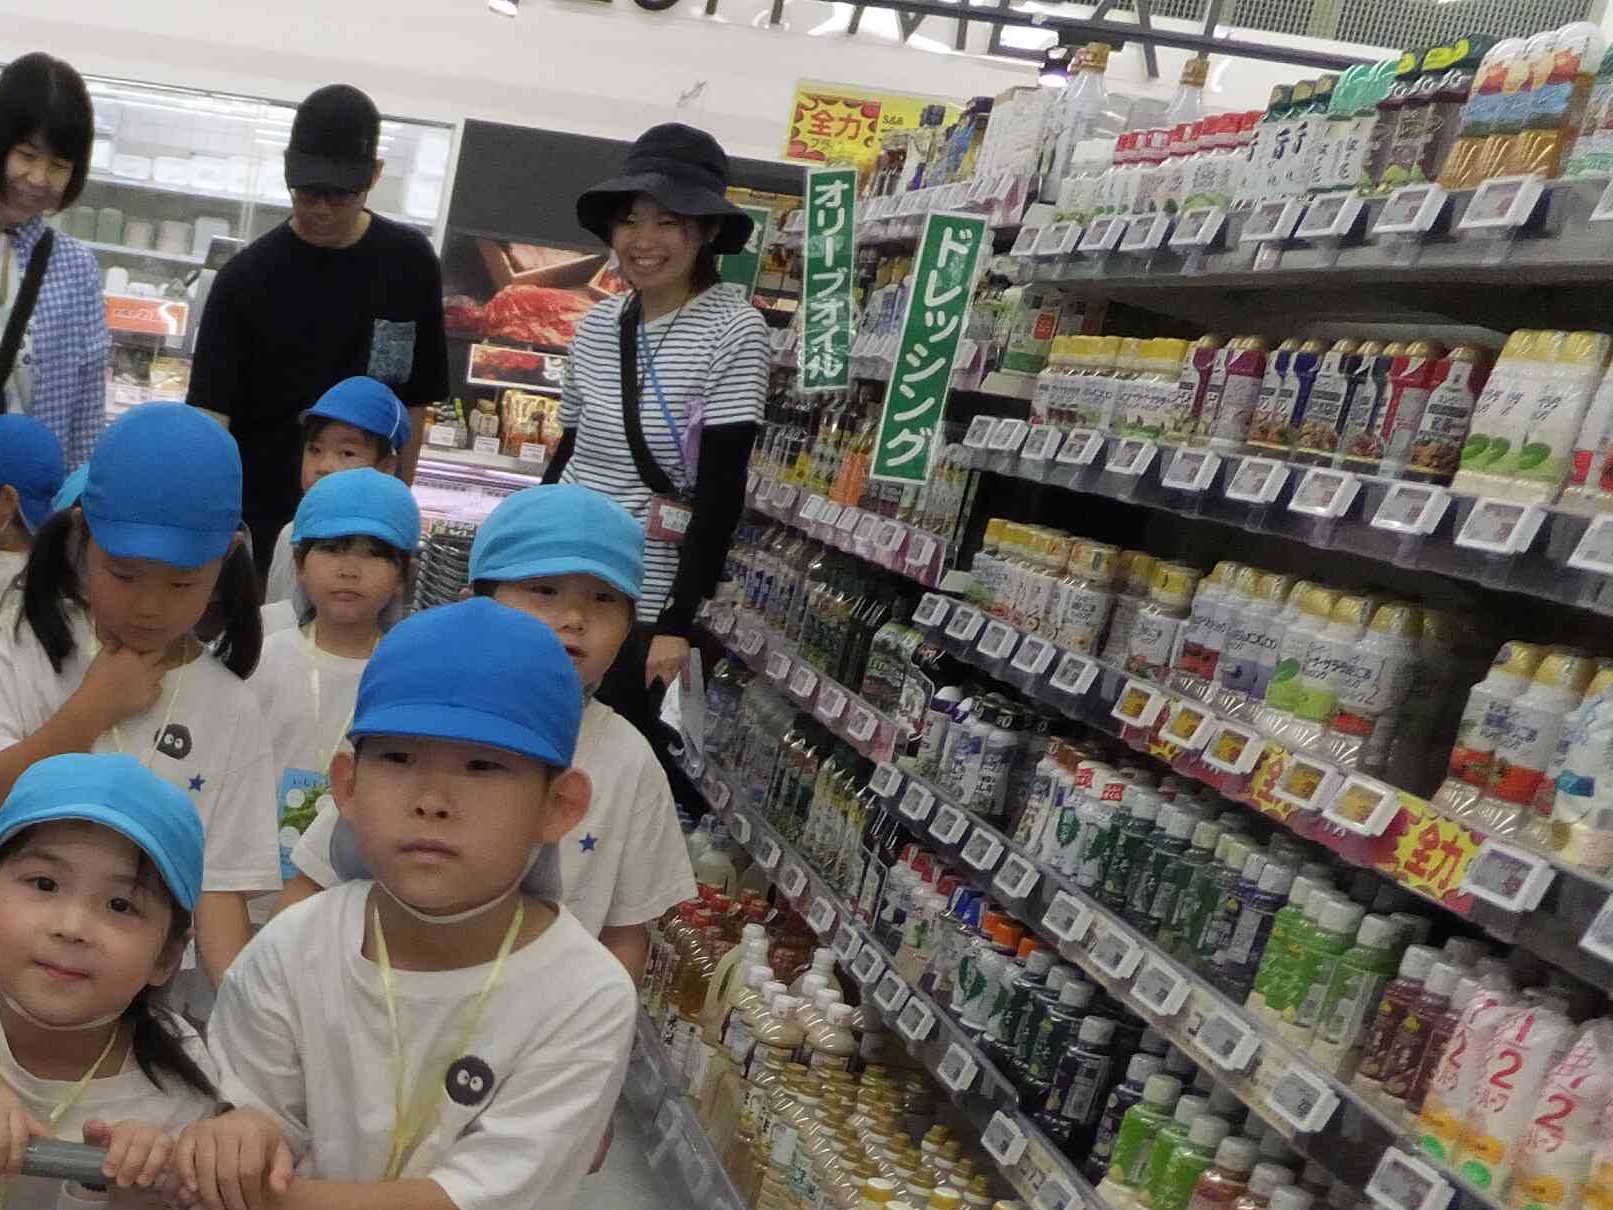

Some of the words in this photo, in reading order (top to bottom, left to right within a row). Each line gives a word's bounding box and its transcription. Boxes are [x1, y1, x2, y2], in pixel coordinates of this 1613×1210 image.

[807, 109, 862, 140] 全力
[885, 226, 973, 467] ドレッシング
